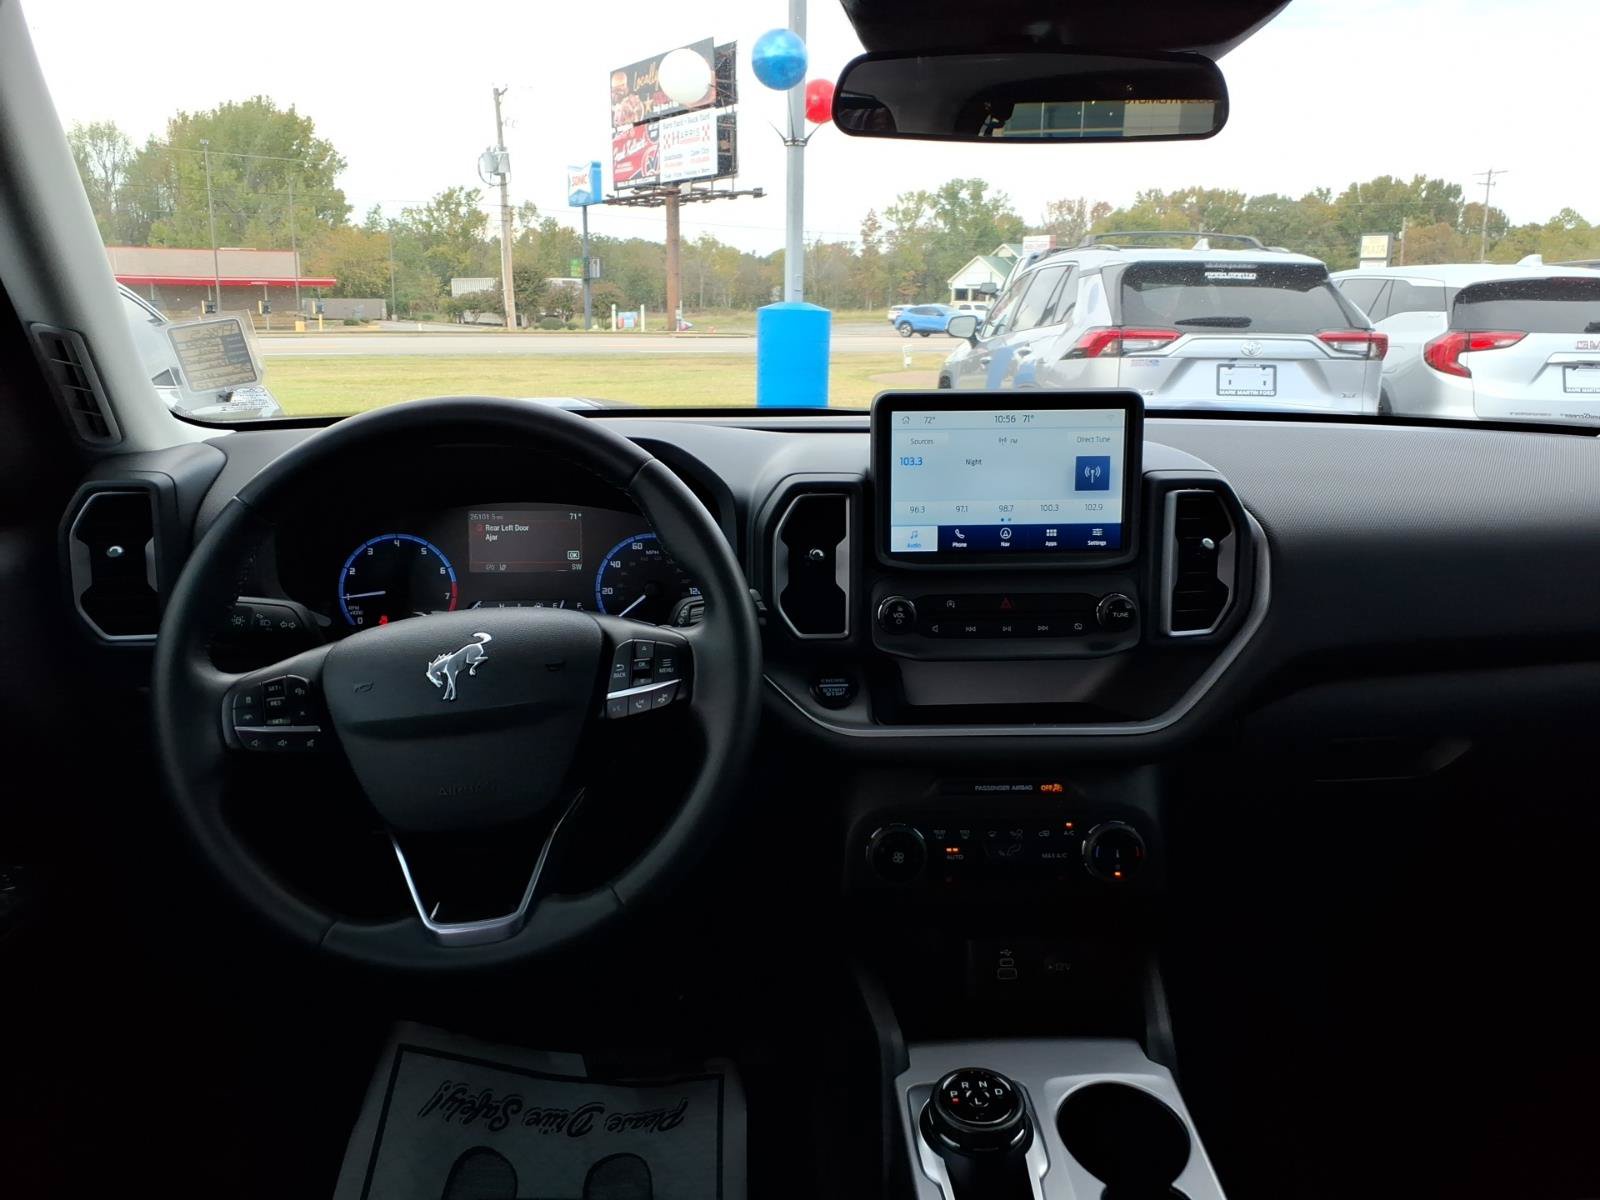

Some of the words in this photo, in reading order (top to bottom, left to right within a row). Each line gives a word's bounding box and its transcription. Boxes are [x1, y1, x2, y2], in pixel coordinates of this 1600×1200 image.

[995, 415, 1016, 424] 10:56
[1023, 414, 1035, 423] 71°
[910, 438, 934, 446] Sources
[1077, 436, 1094, 444] Direct
[899, 456, 923, 466] 103.3
[966, 458, 983, 467] Night
[910, 505, 925, 514] 96.3
[998, 504, 1014, 513] 98.7
[1040, 503, 1059, 512] 100.3
[1085, 503, 1103, 511] 102.9
[485, 533, 498, 542] Ajar
[632, 543, 643, 551] 60
[1045, 540, 1057, 548] Apps
[1087, 539, 1107, 547] Settings
[975, 784, 1011, 792] PASSENGER
[1011, 784, 1033, 792] AIRBAG
[946, 853, 964, 861] AUTO
[961, 1081, 970, 1089] R
[978, 1080, 988, 1088] N
[949, 1090, 959, 1098] P
[994, 1088, 1004, 1096] D
[974, 1097, 983, 1105] L
[523, 1101, 605, 1138] Drive
[605, 1097, 688, 1134] Please
